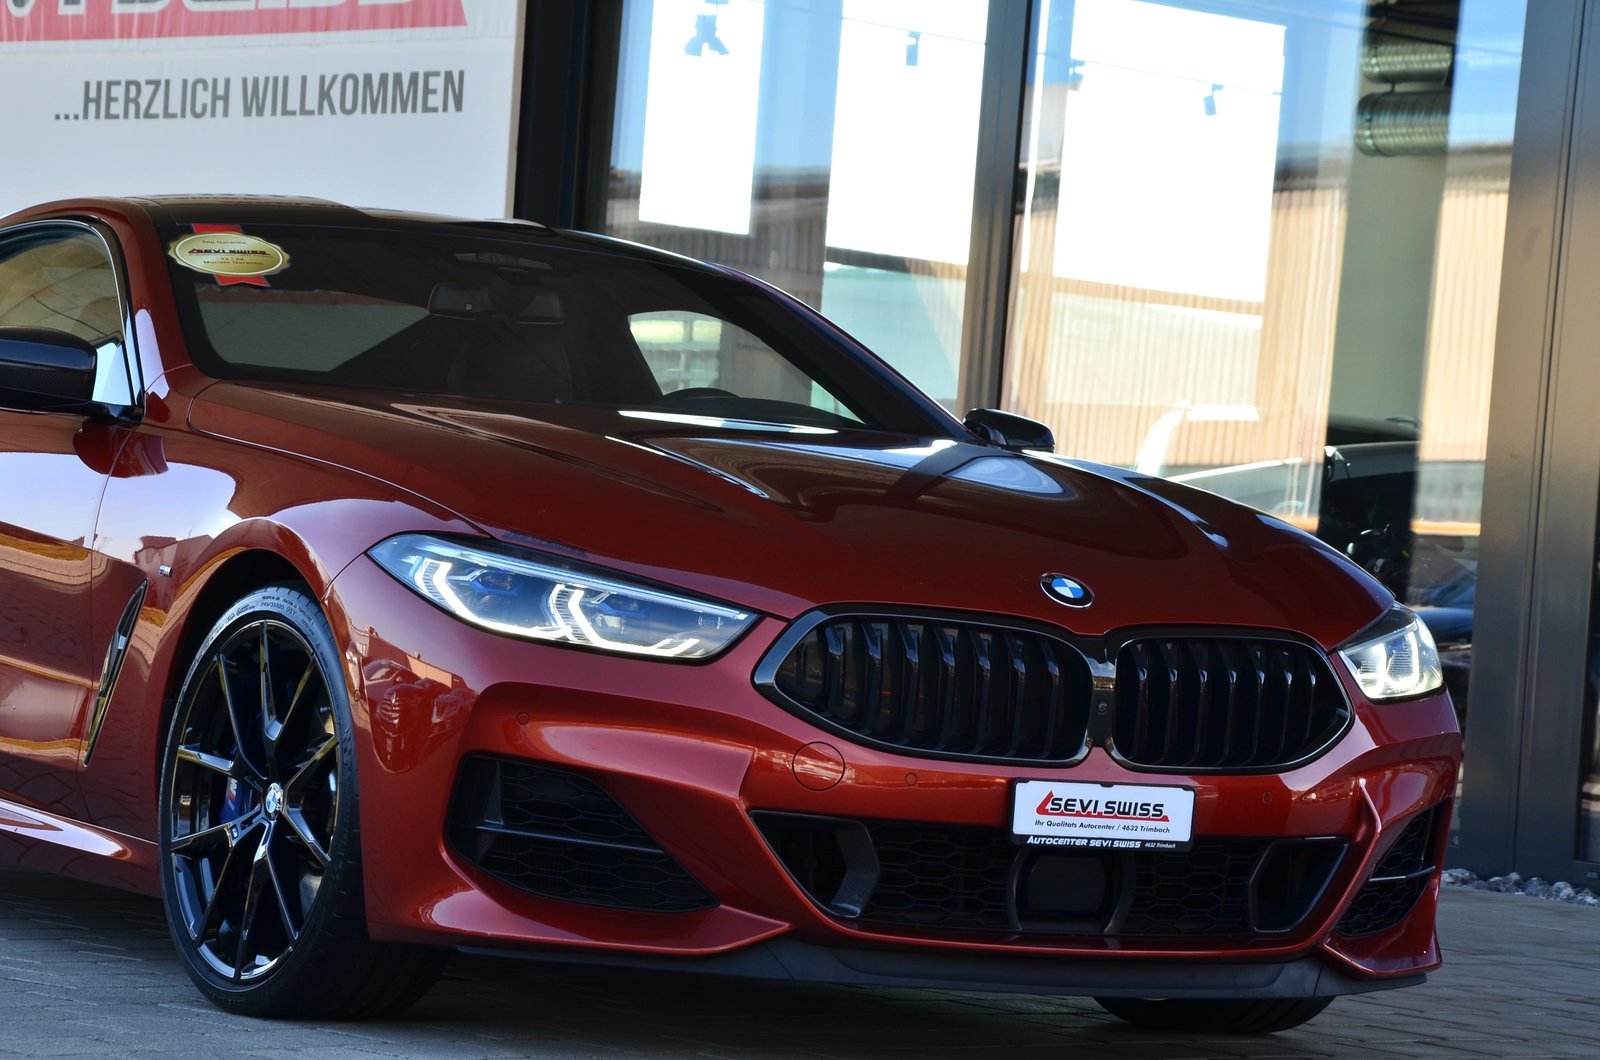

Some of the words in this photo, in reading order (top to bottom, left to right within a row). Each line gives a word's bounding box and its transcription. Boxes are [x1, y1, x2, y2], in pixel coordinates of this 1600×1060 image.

[241, 69, 465, 118] WILLKOMMEN
[1049, 797, 1100, 814] SEVI
[1103, 800, 1164, 818] SWISS
[1034, 819, 1045, 827] Ihr
[1079, 821, 1115, 831] Autocenter
[1121, 824, 1138, 832] 4632
[1140, 825, 1170, 834] Trimbach
[1089, 839, 1112, 848] SEVI
[1113, 840, 1141, 849] SWISS
